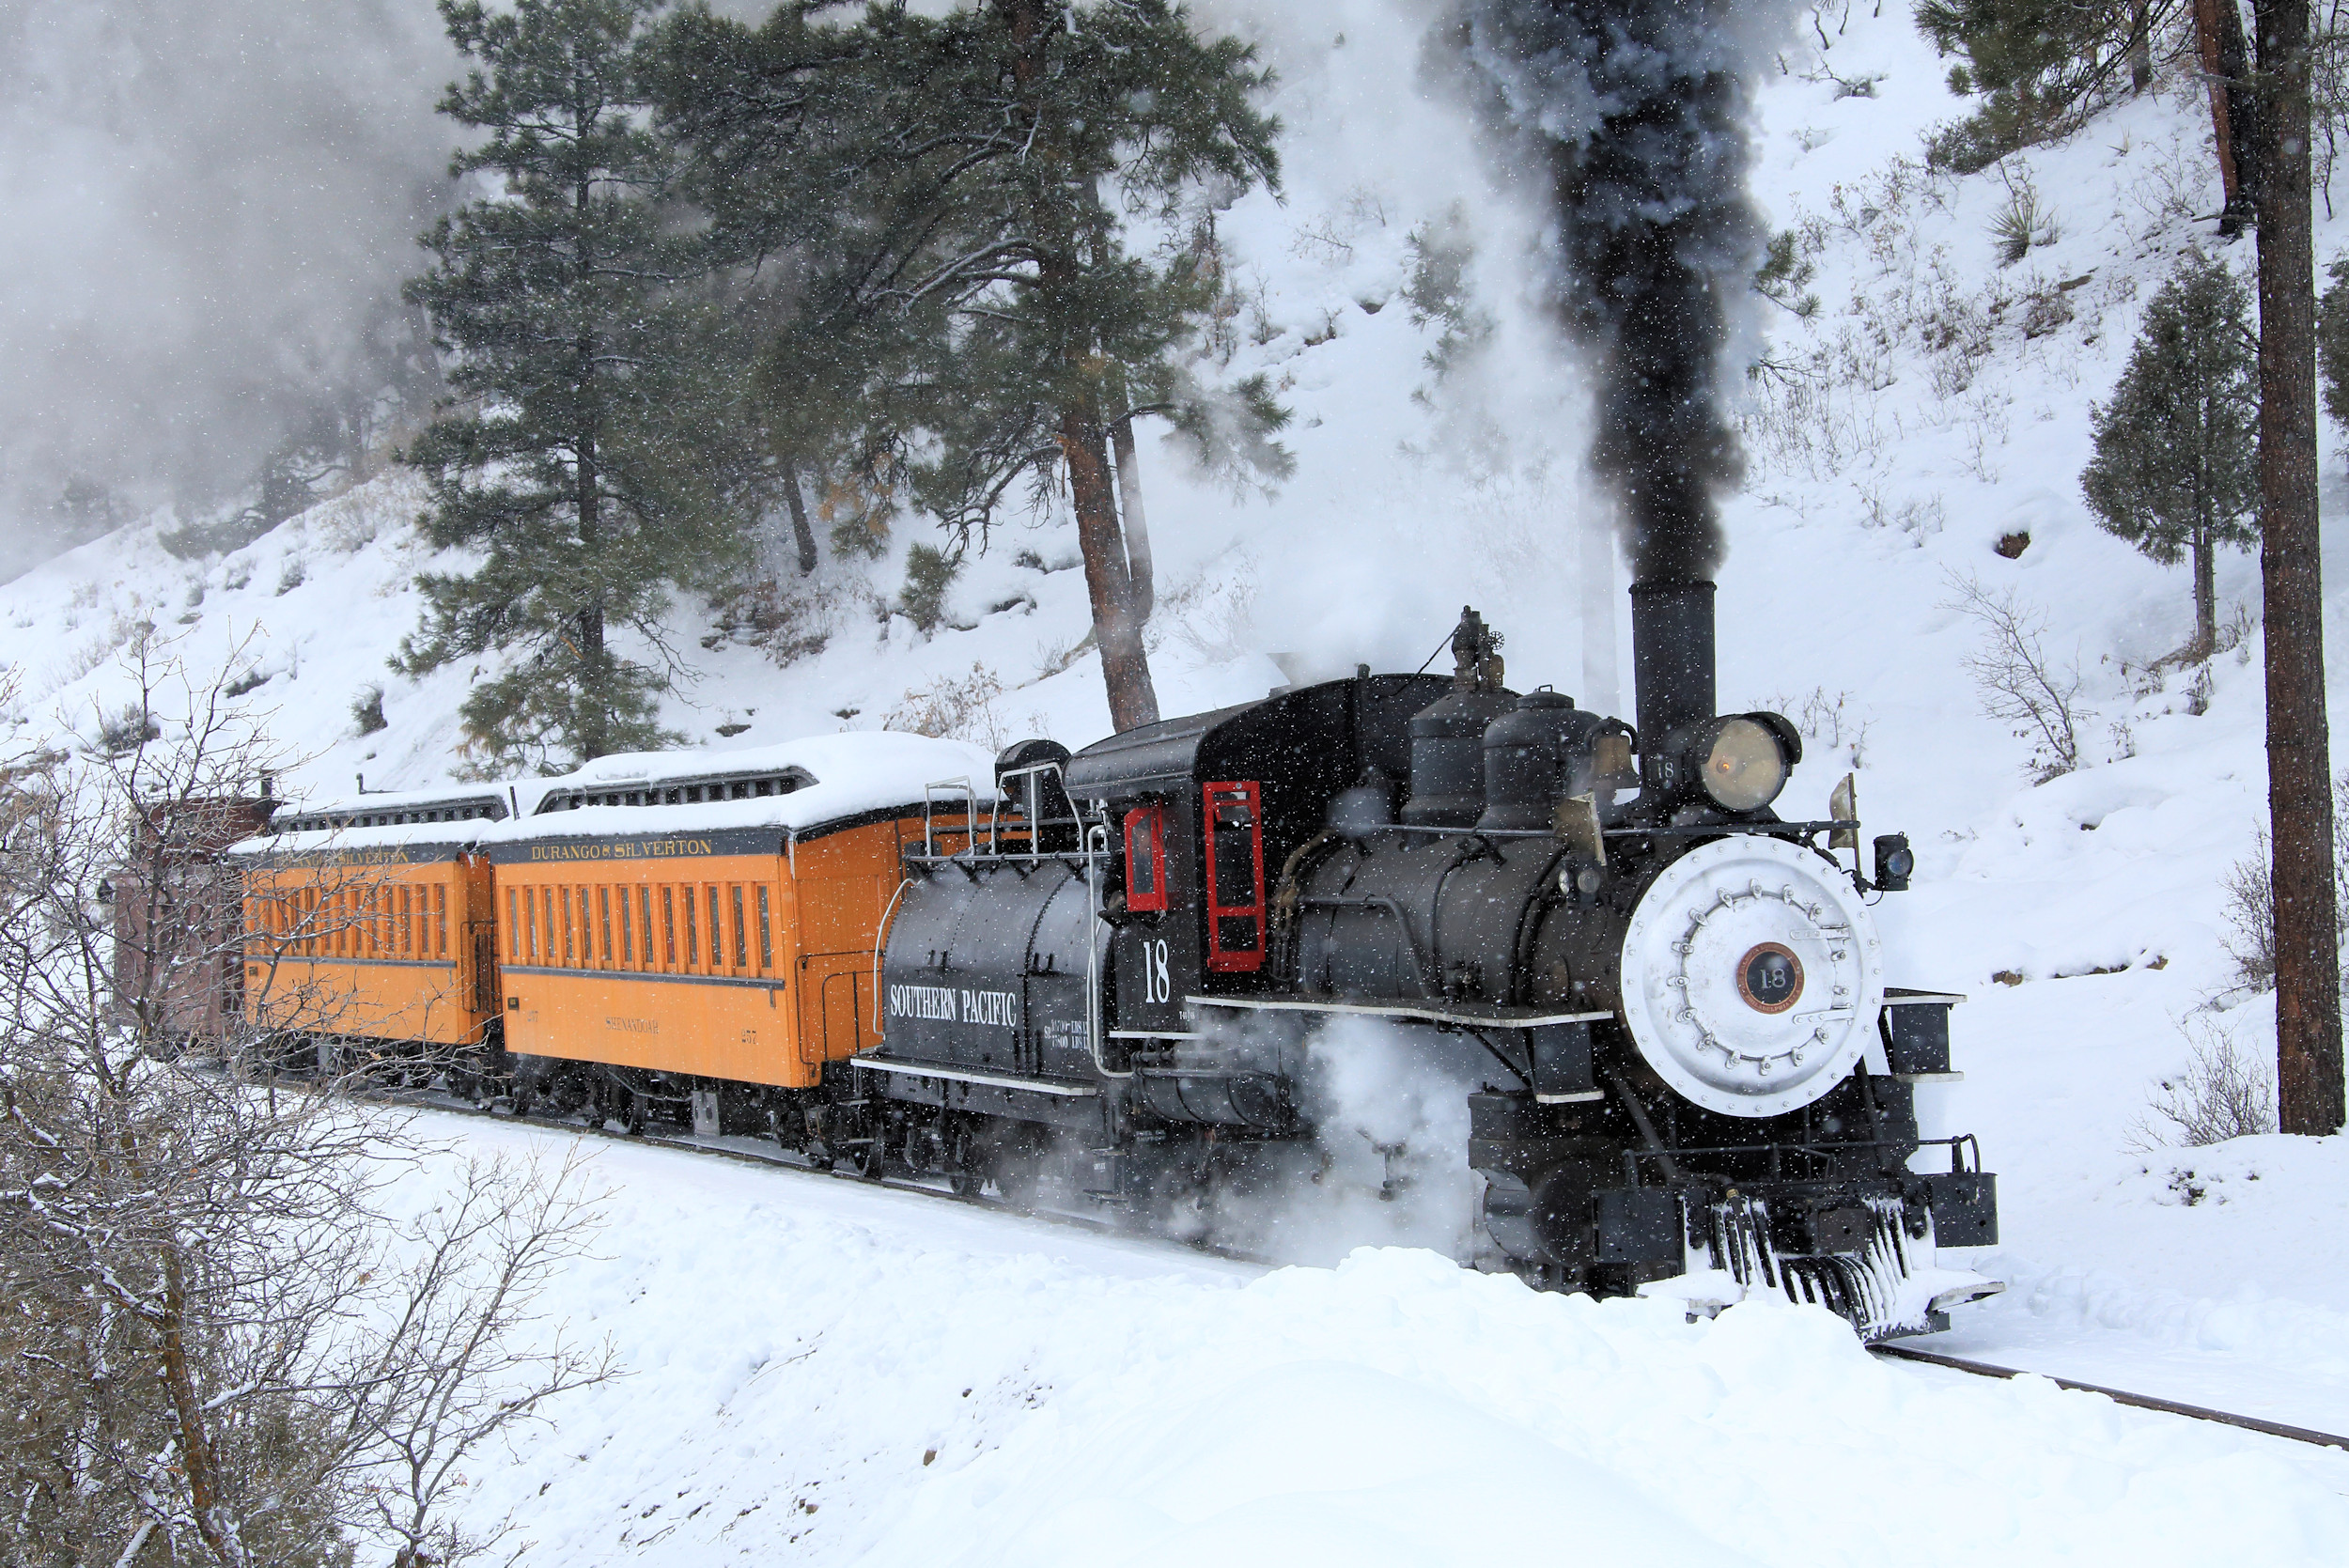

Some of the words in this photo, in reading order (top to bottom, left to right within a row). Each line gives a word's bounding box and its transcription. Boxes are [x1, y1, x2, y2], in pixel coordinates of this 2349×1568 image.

[1657, 762, 1674, 779] 18
[532, 845, 600, 860] DURANGO
[614, 839, 712, 859] SILVERTON
[1143, 939, 1170, 1003] 18
[1760, 968, 1786, 989] 18
[890, 984, 957, 1021] SOUTHERN
[961, 988, 1017, 1027] PACIFIC
[605, 1017, 660, 1034] SHENANDOAH
[740, 1029, 757, 1045] 257
